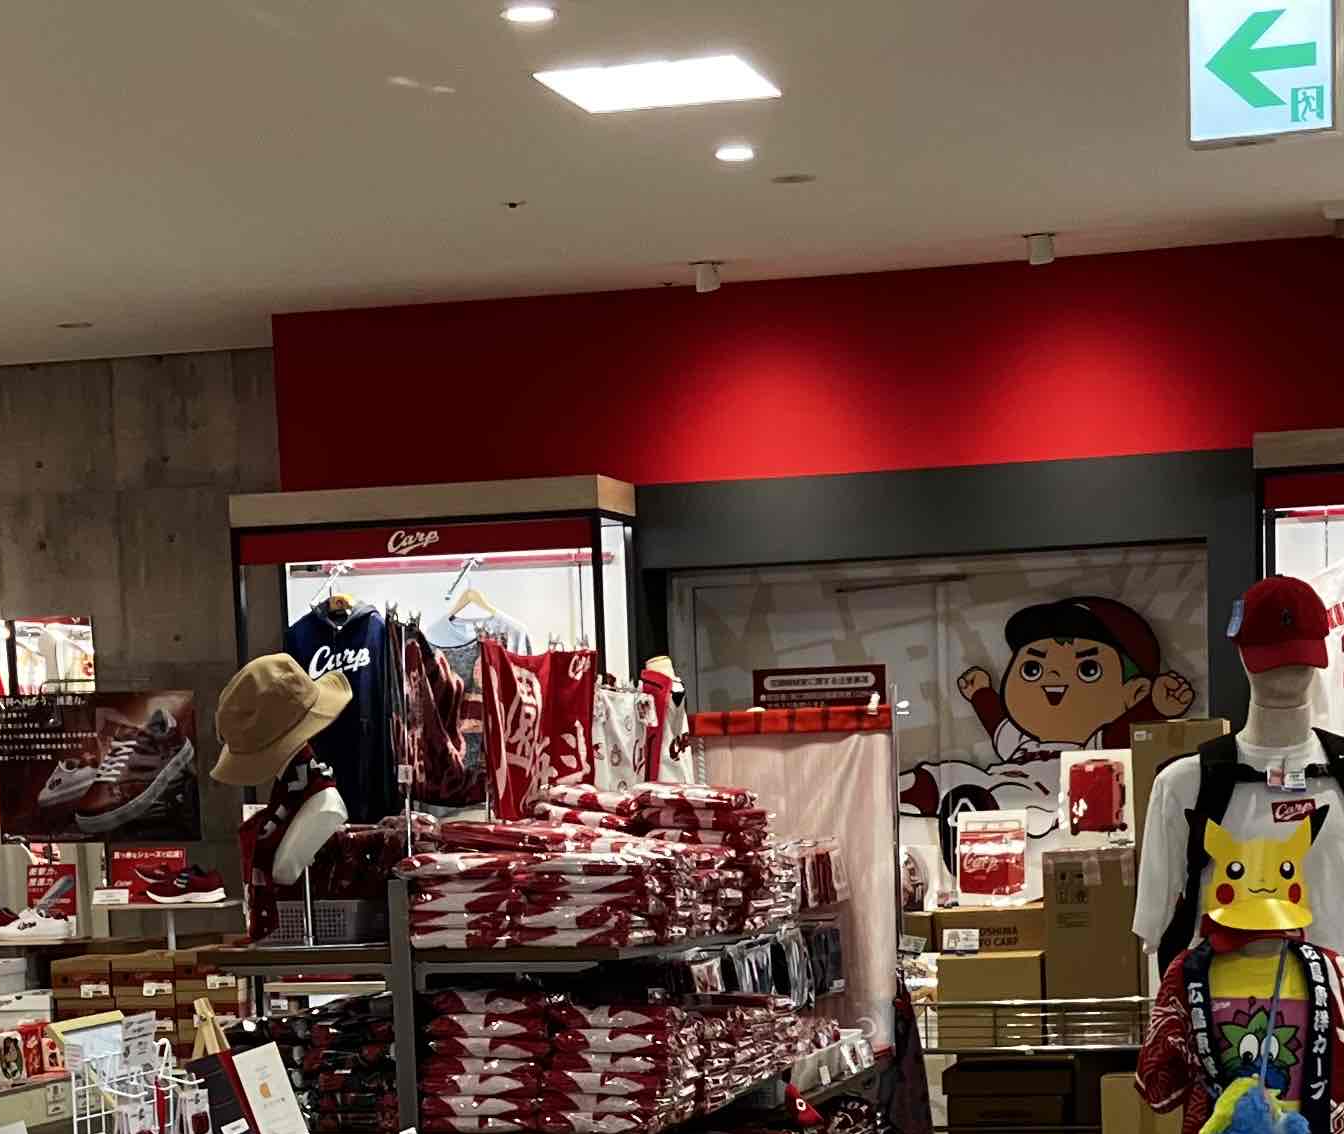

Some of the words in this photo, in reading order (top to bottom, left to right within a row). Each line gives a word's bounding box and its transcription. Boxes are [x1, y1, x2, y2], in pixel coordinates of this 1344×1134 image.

[387, 530, 440, 555] Carp
[308, 645, 371, 680] Carp
[1275, 802, 1314, 820] Carp
[963, 851, 999, 874] Carp
[1299, 944, 1330, 1100] 広島東洋カープ
